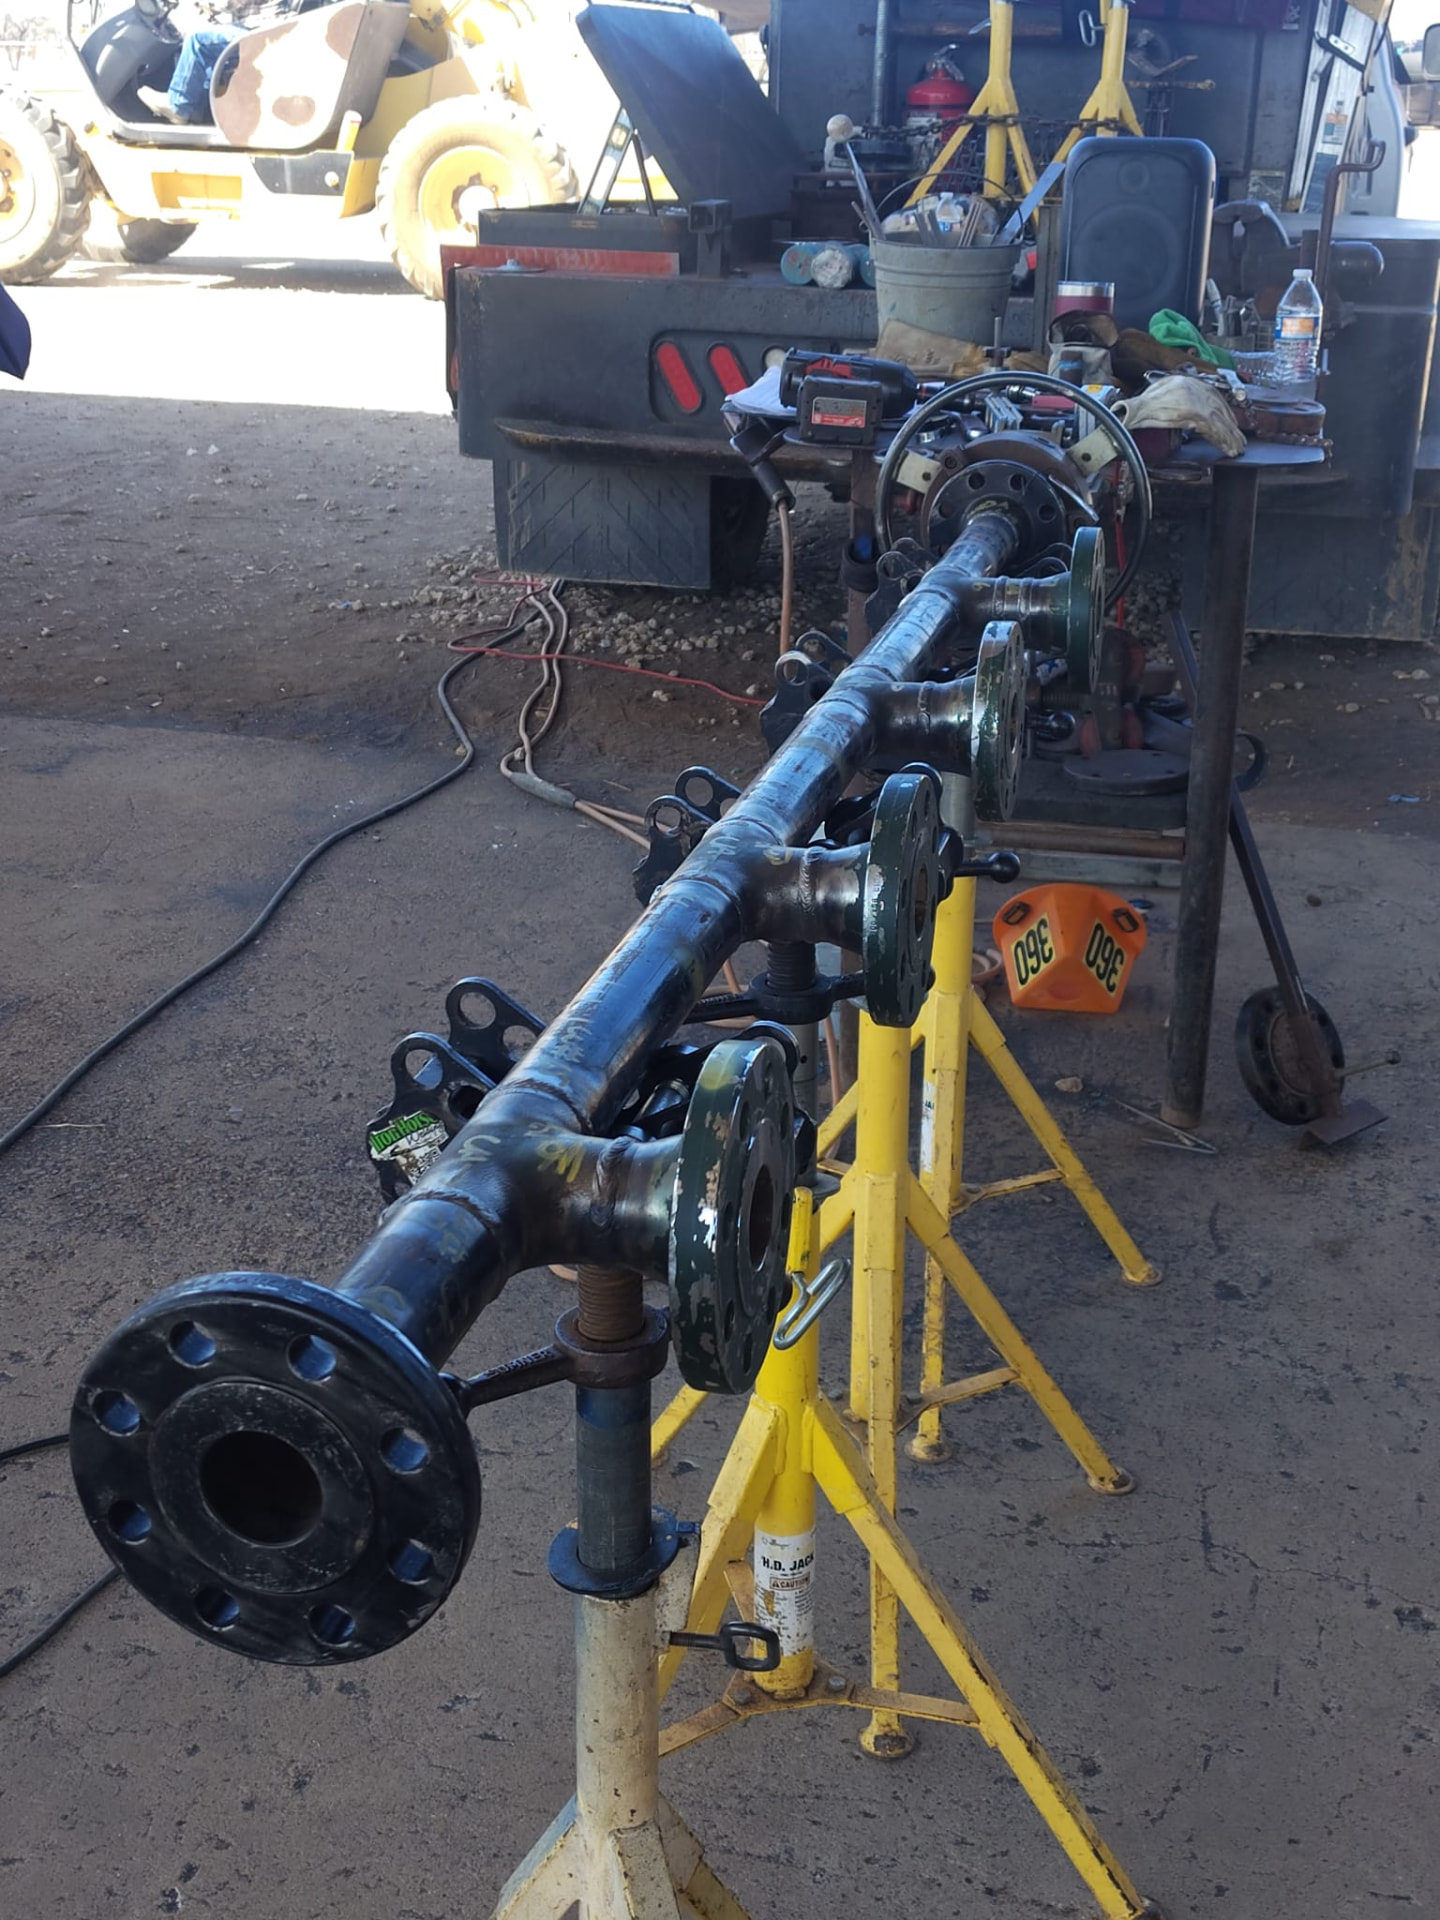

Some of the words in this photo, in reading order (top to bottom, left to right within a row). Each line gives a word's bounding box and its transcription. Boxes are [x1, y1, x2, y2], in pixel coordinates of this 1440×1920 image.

[1014, 918, 1055, 986] 360
[1085, 923, 1125, 993] 360
[761, 1556, 786, 1572] H.D.
